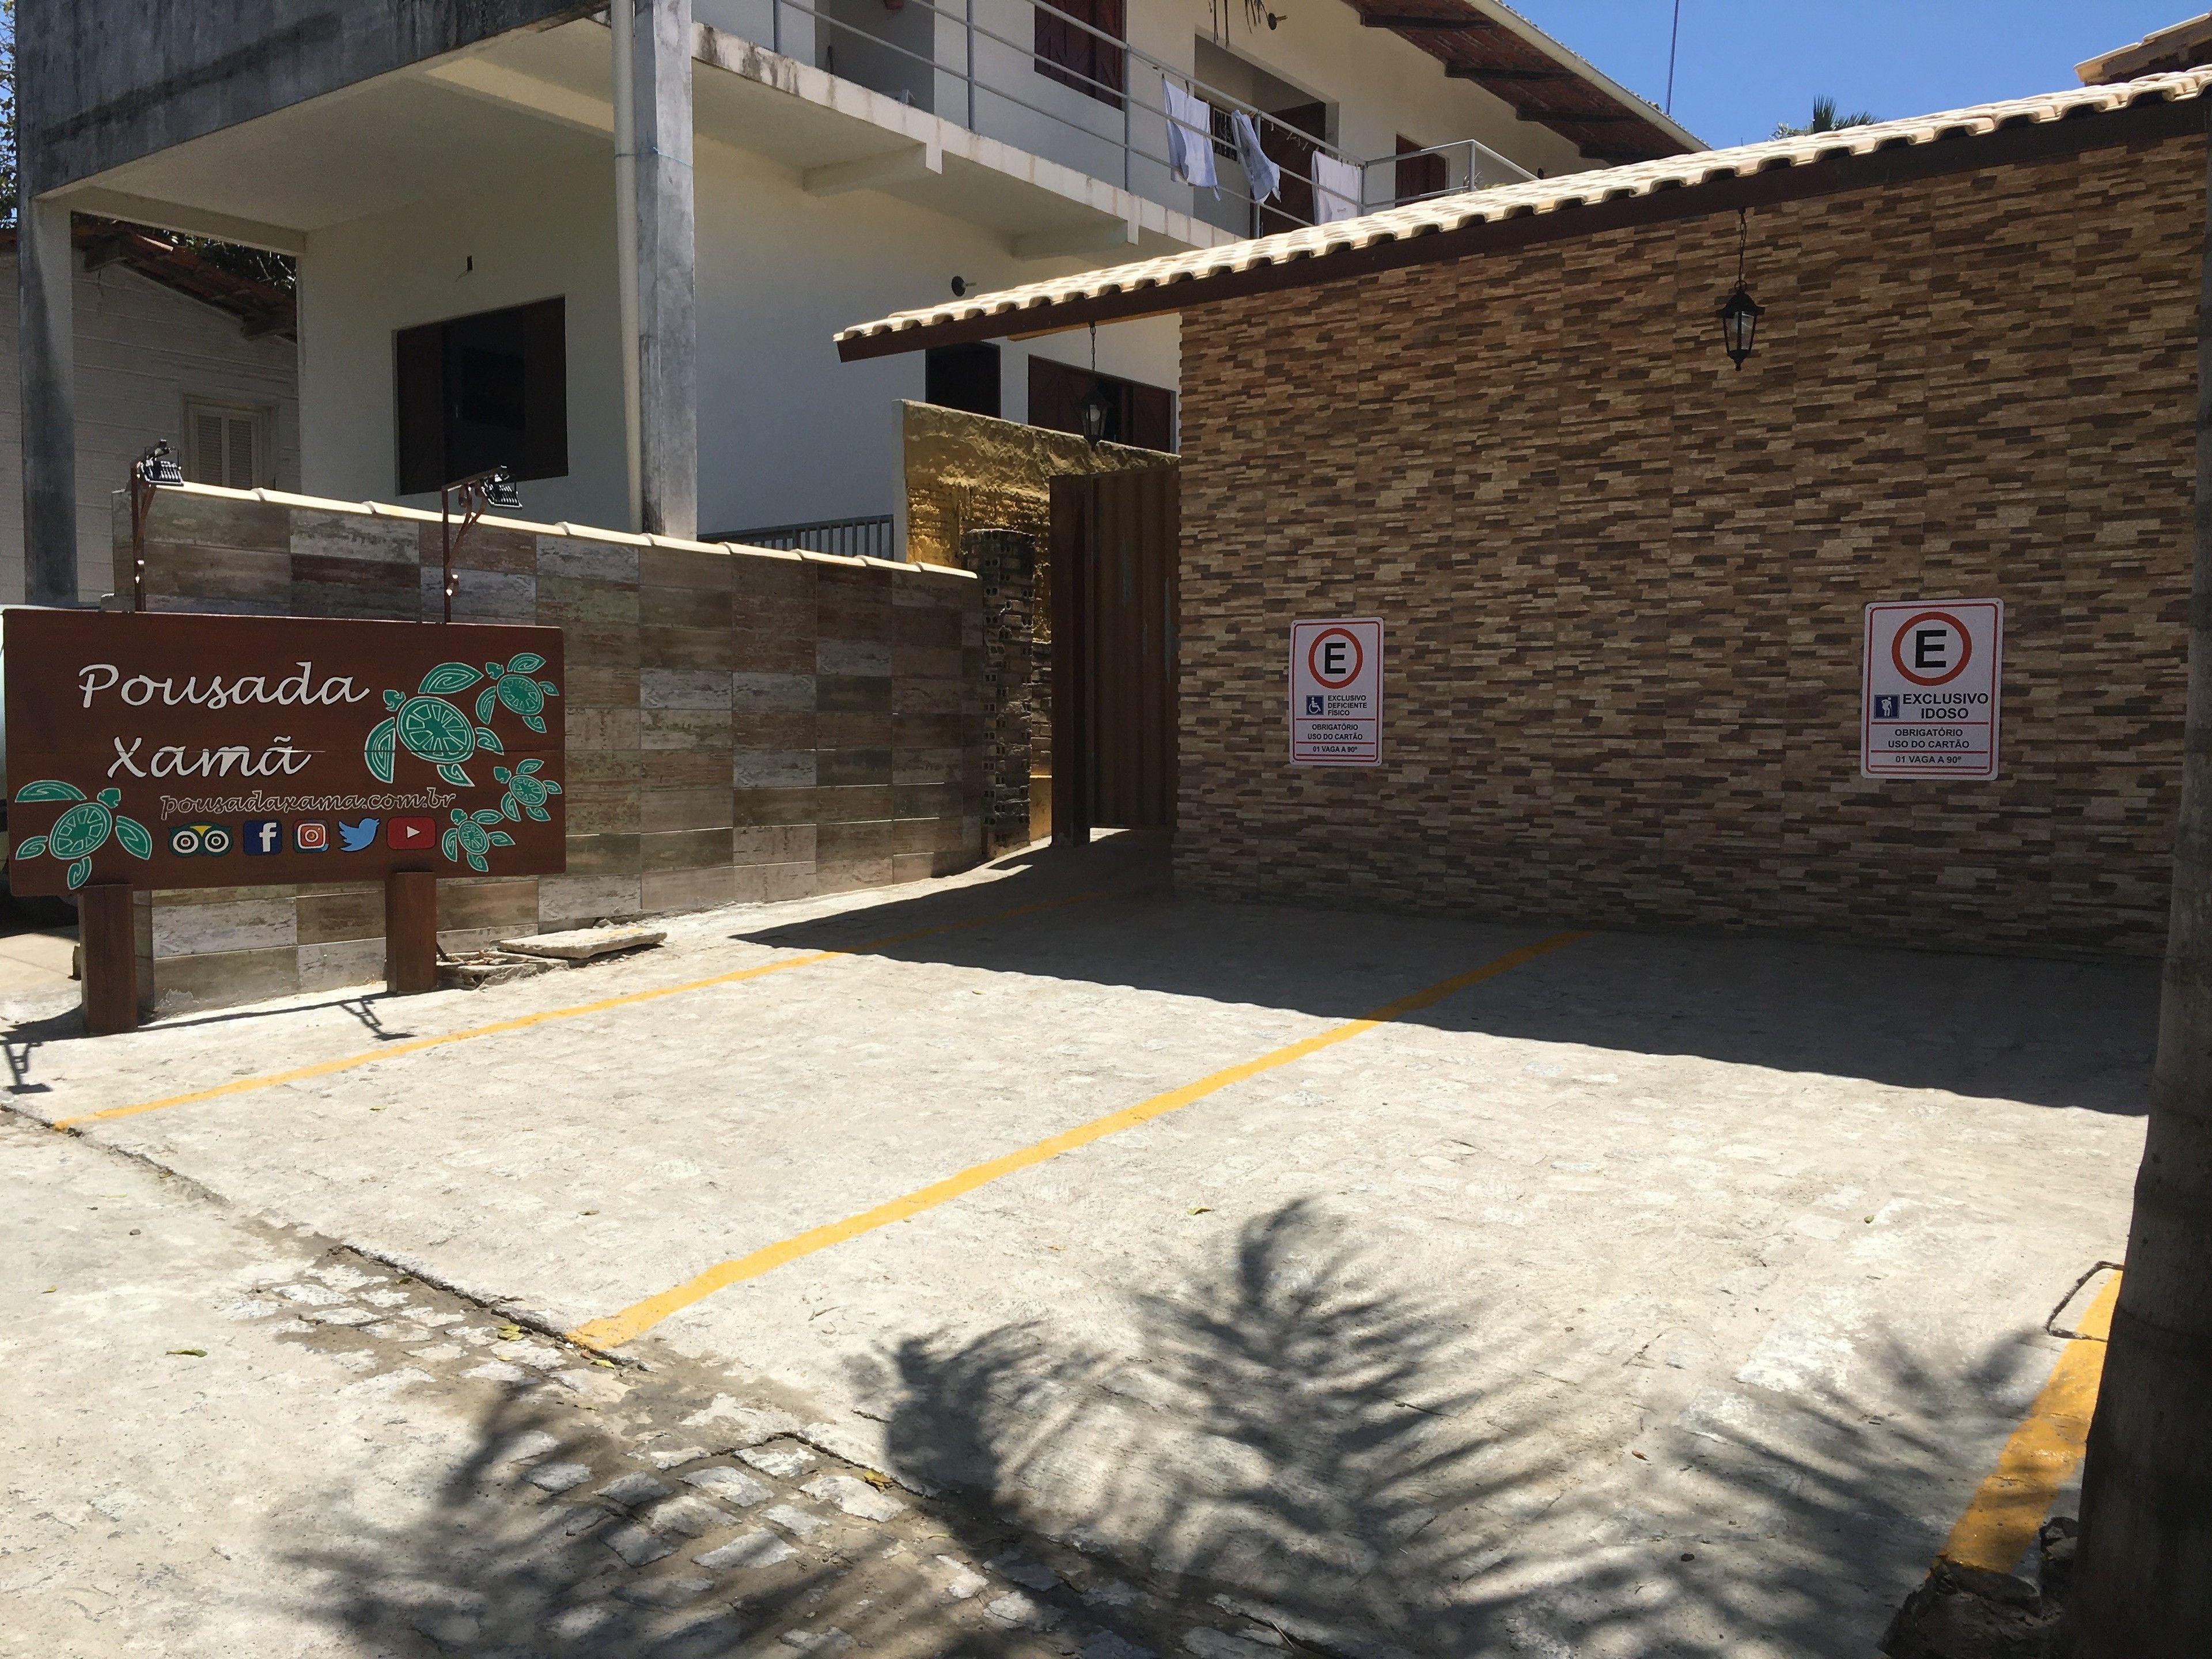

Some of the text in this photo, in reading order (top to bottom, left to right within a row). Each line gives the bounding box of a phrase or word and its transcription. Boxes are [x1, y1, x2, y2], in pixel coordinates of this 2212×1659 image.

[1324, 642, 1346, 674] E
[1915, 630, 1947, 668] E
[78, 661, 370, 710] Pousada
[1903, 693, 1988, 704] EXCLUSIVO
[1921, 708, 1969, 719] IDOSO
[1335, 732, 1363, 740] CARTÃO
[1895, 728, 1963, 737] OBRIGATÓRIO
[1928, 740, 1969, 748] CARTÃO
[107, 736, 312, 778] Xamã
[160, 787, 456, 820] pousadaxama.com.br
